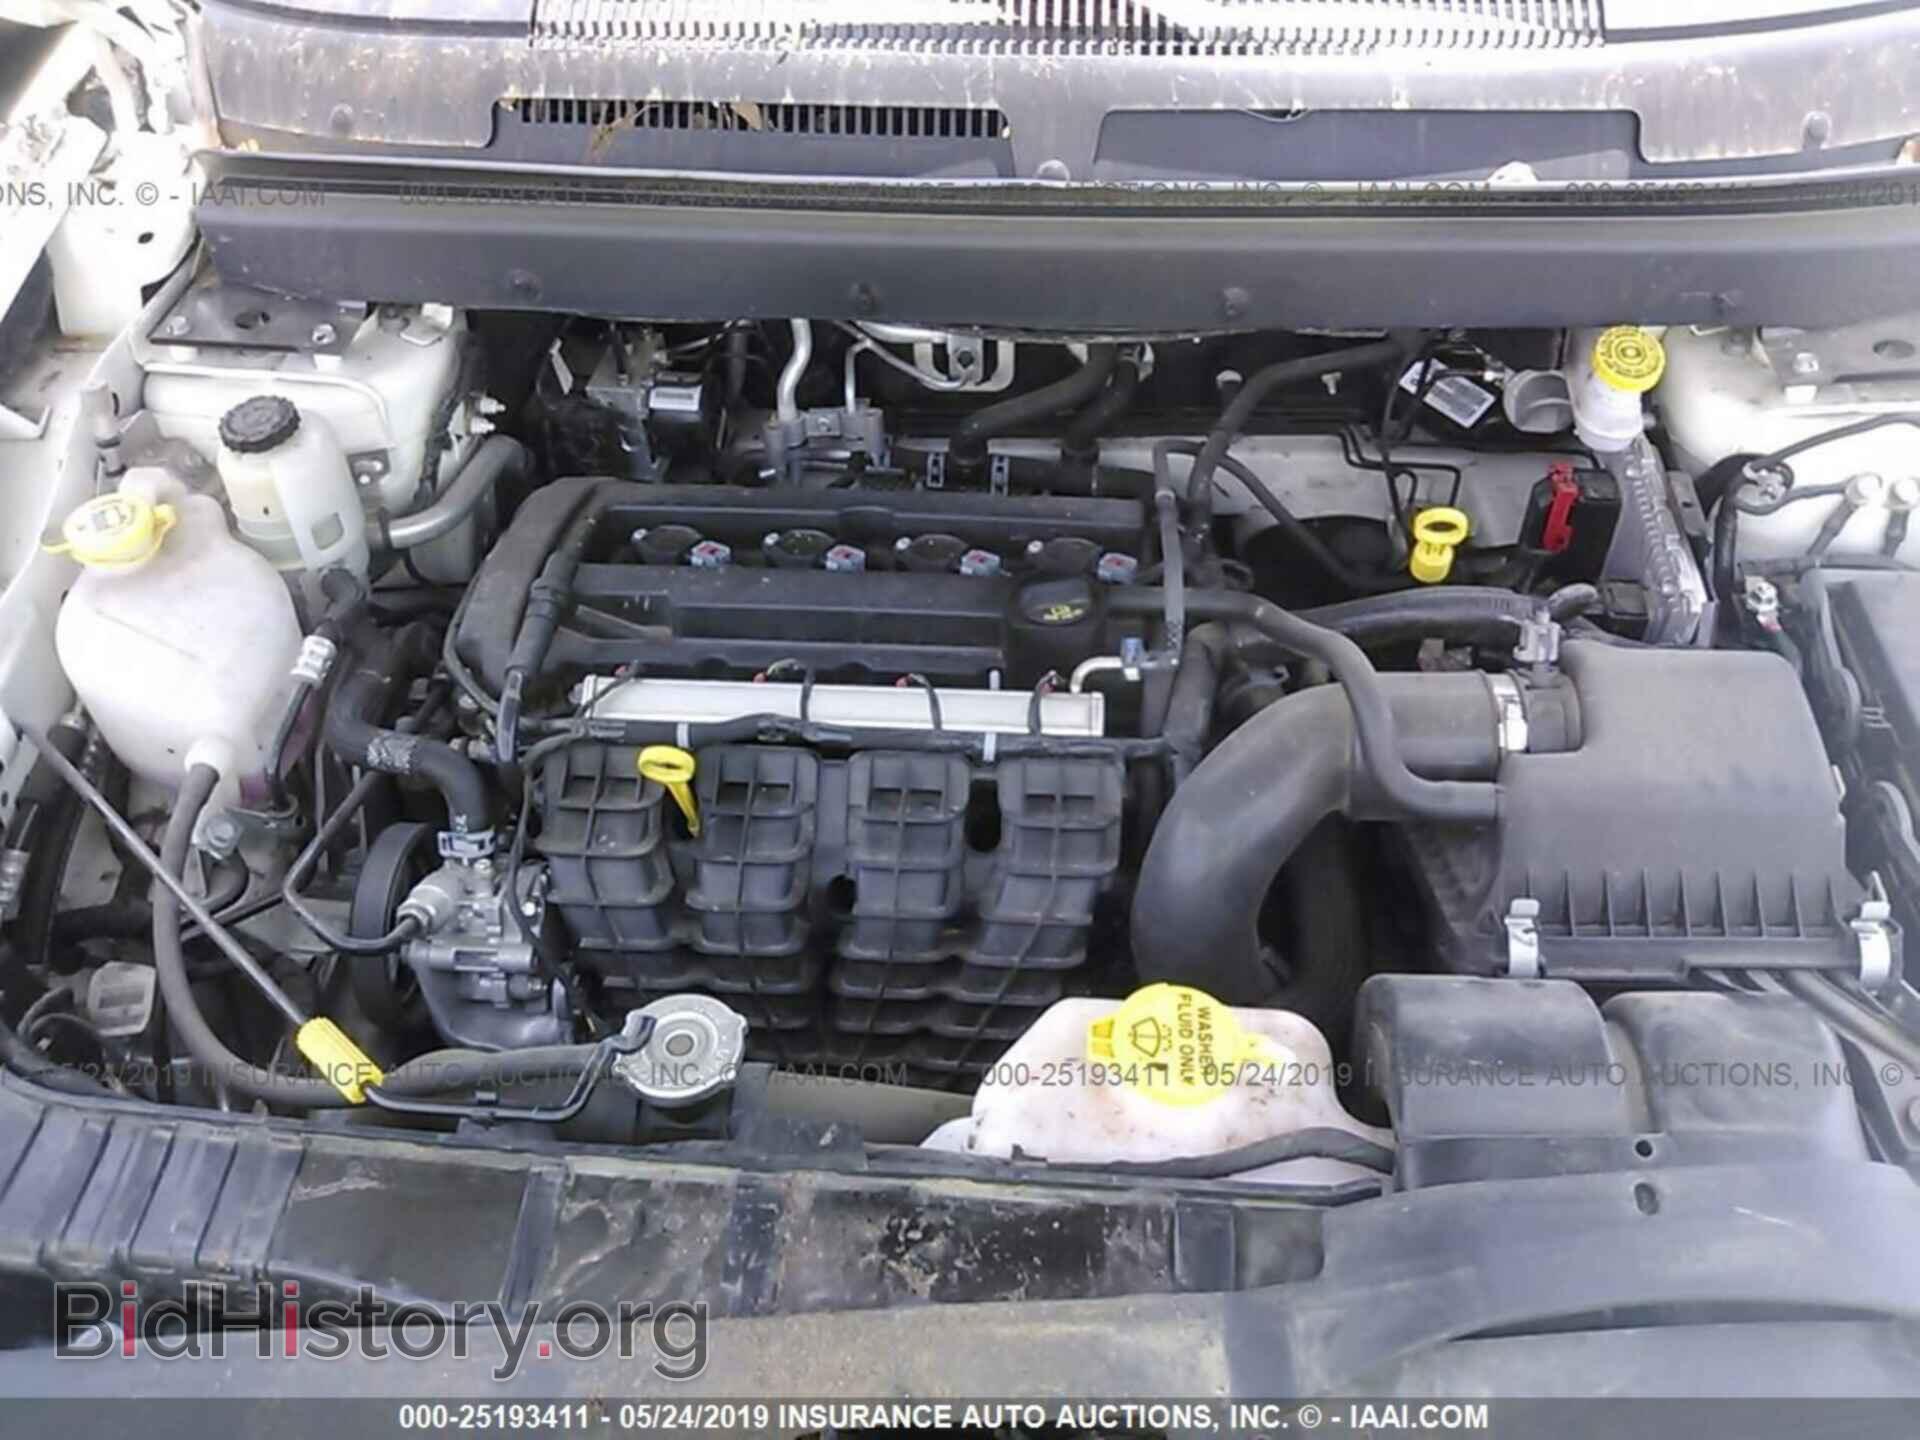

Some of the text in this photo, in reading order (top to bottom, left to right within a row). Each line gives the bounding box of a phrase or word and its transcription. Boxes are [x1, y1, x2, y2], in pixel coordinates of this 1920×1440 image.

[1176, 993, 1195, 1086] FLUID ONLY
[1197, 1007, 1215, 1077] WASHER
